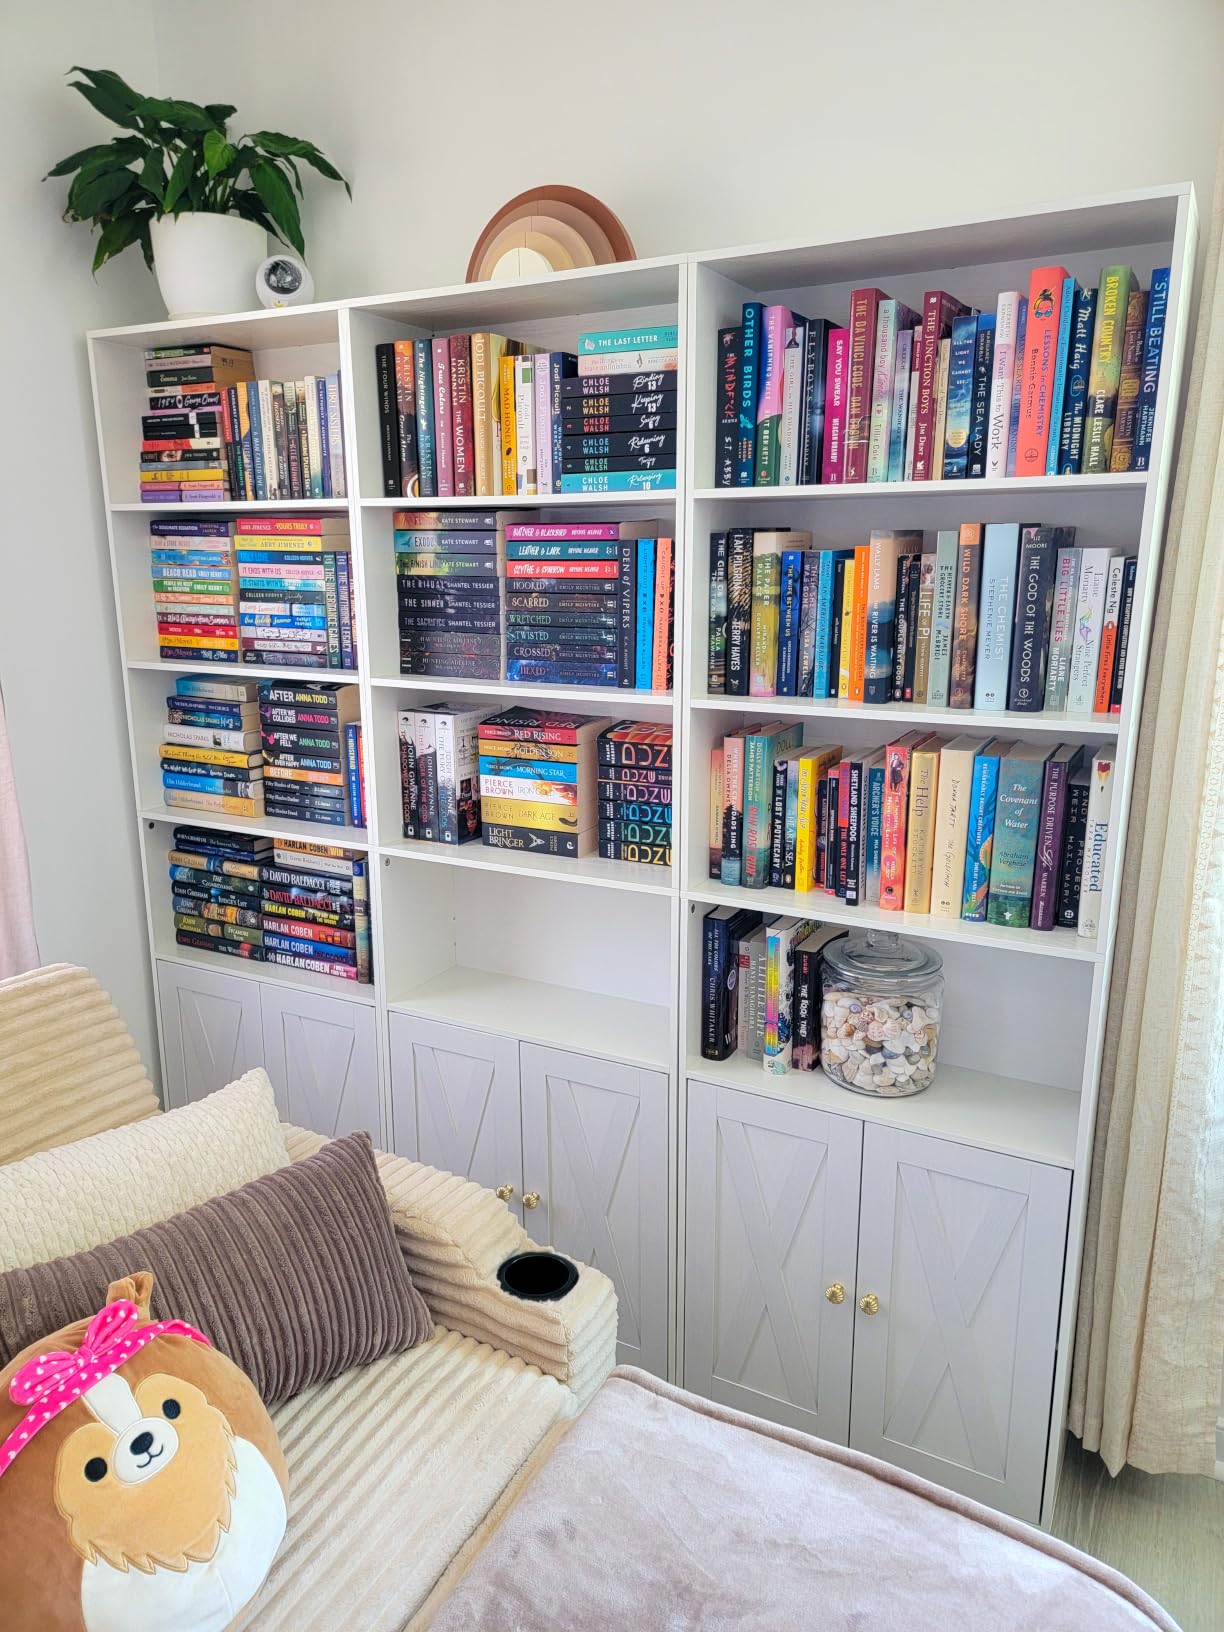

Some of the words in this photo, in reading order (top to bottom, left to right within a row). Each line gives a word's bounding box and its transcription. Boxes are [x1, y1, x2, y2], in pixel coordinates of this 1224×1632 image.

[1104, 276, 1119, 316] BROKEN
[1150, 281, 1166, 323] STILL
[856, 300, 867, 316] THE
[926, 311, 936, 332] THE
[1076, 307, 1091, 338] Matt
[598, 339, 612, 347] THE
[614, 337, 631, 346] LAST
[633, 335, 658, 344] LETTER
[744, 308, 755, 358] OTHER
[1100, 319, 1115, 364] COUNTRY
[475, 338, 484, 367] JODI
[853, 337, 865, 362] VINCI
[923, 334, 935, 385] JUNCTION
[1070, 343, 1087, 370] Haig
[835, 359, 843, 375] YOU
[1144, 327, 1162, 393] BEATING
[457, 359, 467, 403] KRISTIN
[583, 378, 610, 387] CHLOE
[633, 373, 665, 391] Binding
[742, 366, 752, 407] BIRDS
[852, 365, 863, 388] CODE
[977, 375, 986, 397] THE
[476, 373, 486, 422] PICOULT
[582, 386, 610, 395] WALSH
[833, 378, 842, 407] SWEAR
[158, 397, 175, 407] 1984
[583, 399, 609, 407] CHLOE
[583, 407, 609, 415] WALSH
[921, 387, 930, 415] BOYS
[1035, 384, 1046, 437] CHEMISTRY
[1094, 389, 1105, 414] CLARE
[583, 417, 610, 425] CHLOE
[976, 402, 985, 422] SEA
[504, 414, 512, 445] HONEY
[584, 424, 610, 432] WALSH
[992, 415, 1004, 450] Work
[1061, 412, 1072, 450] LIBRARY
[1093, 417, 1103, 444] LESLIE
[456, 426, 466, 473] WOMEN
[583, 438, 609, 446] CHLOE
[583, 446, 609, 454] WALSH
[918, 438, 927, 455] DENT
[974, 426, 983, 456] LADY
[1089, 446, 1099, 467] HALL
[582, 476, 609, 484] CHLOE
[582, 483, 609, 491] WALSH
[962, 548, 971, 573] WILD
[1030, 555, 1040, 570] THE
[1062, 558, 1071, 577] BIG
[961, 577, 970, 604] DARK
[1000, 576, 1009, 600] THE
[1028, 574, 1040, 603] GOD
[1110, 567, 1121, 598] Celeste
[405, 599, 416, 607] THE
[512, 598, 549, 608] SCARRED
[1058, 580, 1069, 620] LITTLE
[1107, 600, 1117, 614] Ng
[509, 615, 551, 624] WRETCHED
[1027, 606, 1036, 618] OF
[732, 620, 741, 647] TERRY
[959, 608, 969, 641] SHORE
[995, 607, 1007, 661] CHEMIST
[1024, 621, 1035, 635] THE
[1055, 621, 1064, 643] LIES
[515, 631, 549, 640] TWISTED
[514, 647, 551, 656] CROSSED
[731, 647, 740, 671] HAYES
[1020, 639, 1033, 682] WOODS
[1048, 647, 1059, 692] MORIARTY
[1057, 657, 1066, 682] LIANE
[269, 690, 294, 701] AFTER
[296, 693, 311, 702] ANNA
[312, 695, 328, 704] TODD
[298, 714, 312, 722] ANNA
[312, 715, 329, 724] TODD
[279, 739, 292, 747] FELL
[299, 738, 313, 746] ANNA
[314, 739, 330, 748] TODD
[514, 730, 533, 739] RED
[535, 731, 561, 741] RISING
[300, 757, 315, 767] ANNA
[316, 759, 331, 769] TODD
[484, 779, 513, 788] PIERCE
[485, 787, 514, 796] BROWN
[850, 770, 858, 806] SHETLAND
[1013, 784, 1027, 792] The
[1000, 794, 1037, 804] Covenant
[1015, 808, 1023, 816] of
[489, 827, 514, 837] LIGHT
[1005, 819, 1028, 829] Water
[489, 836, 524, 848] BRINGER
[772, 819, 782, 868] APOTHECARY
[1089, 822, 1108, 892] Educated
[264, 903, 286, 914] HARLAN
[288, 908, 305, 918] COBEN
[263, 920, 289, 934] HARLAN
[291, 925, 312, 938] COBEN
[264, 936, 289, 950] HARLAN
[291, 942, 313, 954] COBEN
[276, 954, 305, 969] HARLAN
[306, 958, 329, 973] COBEN
